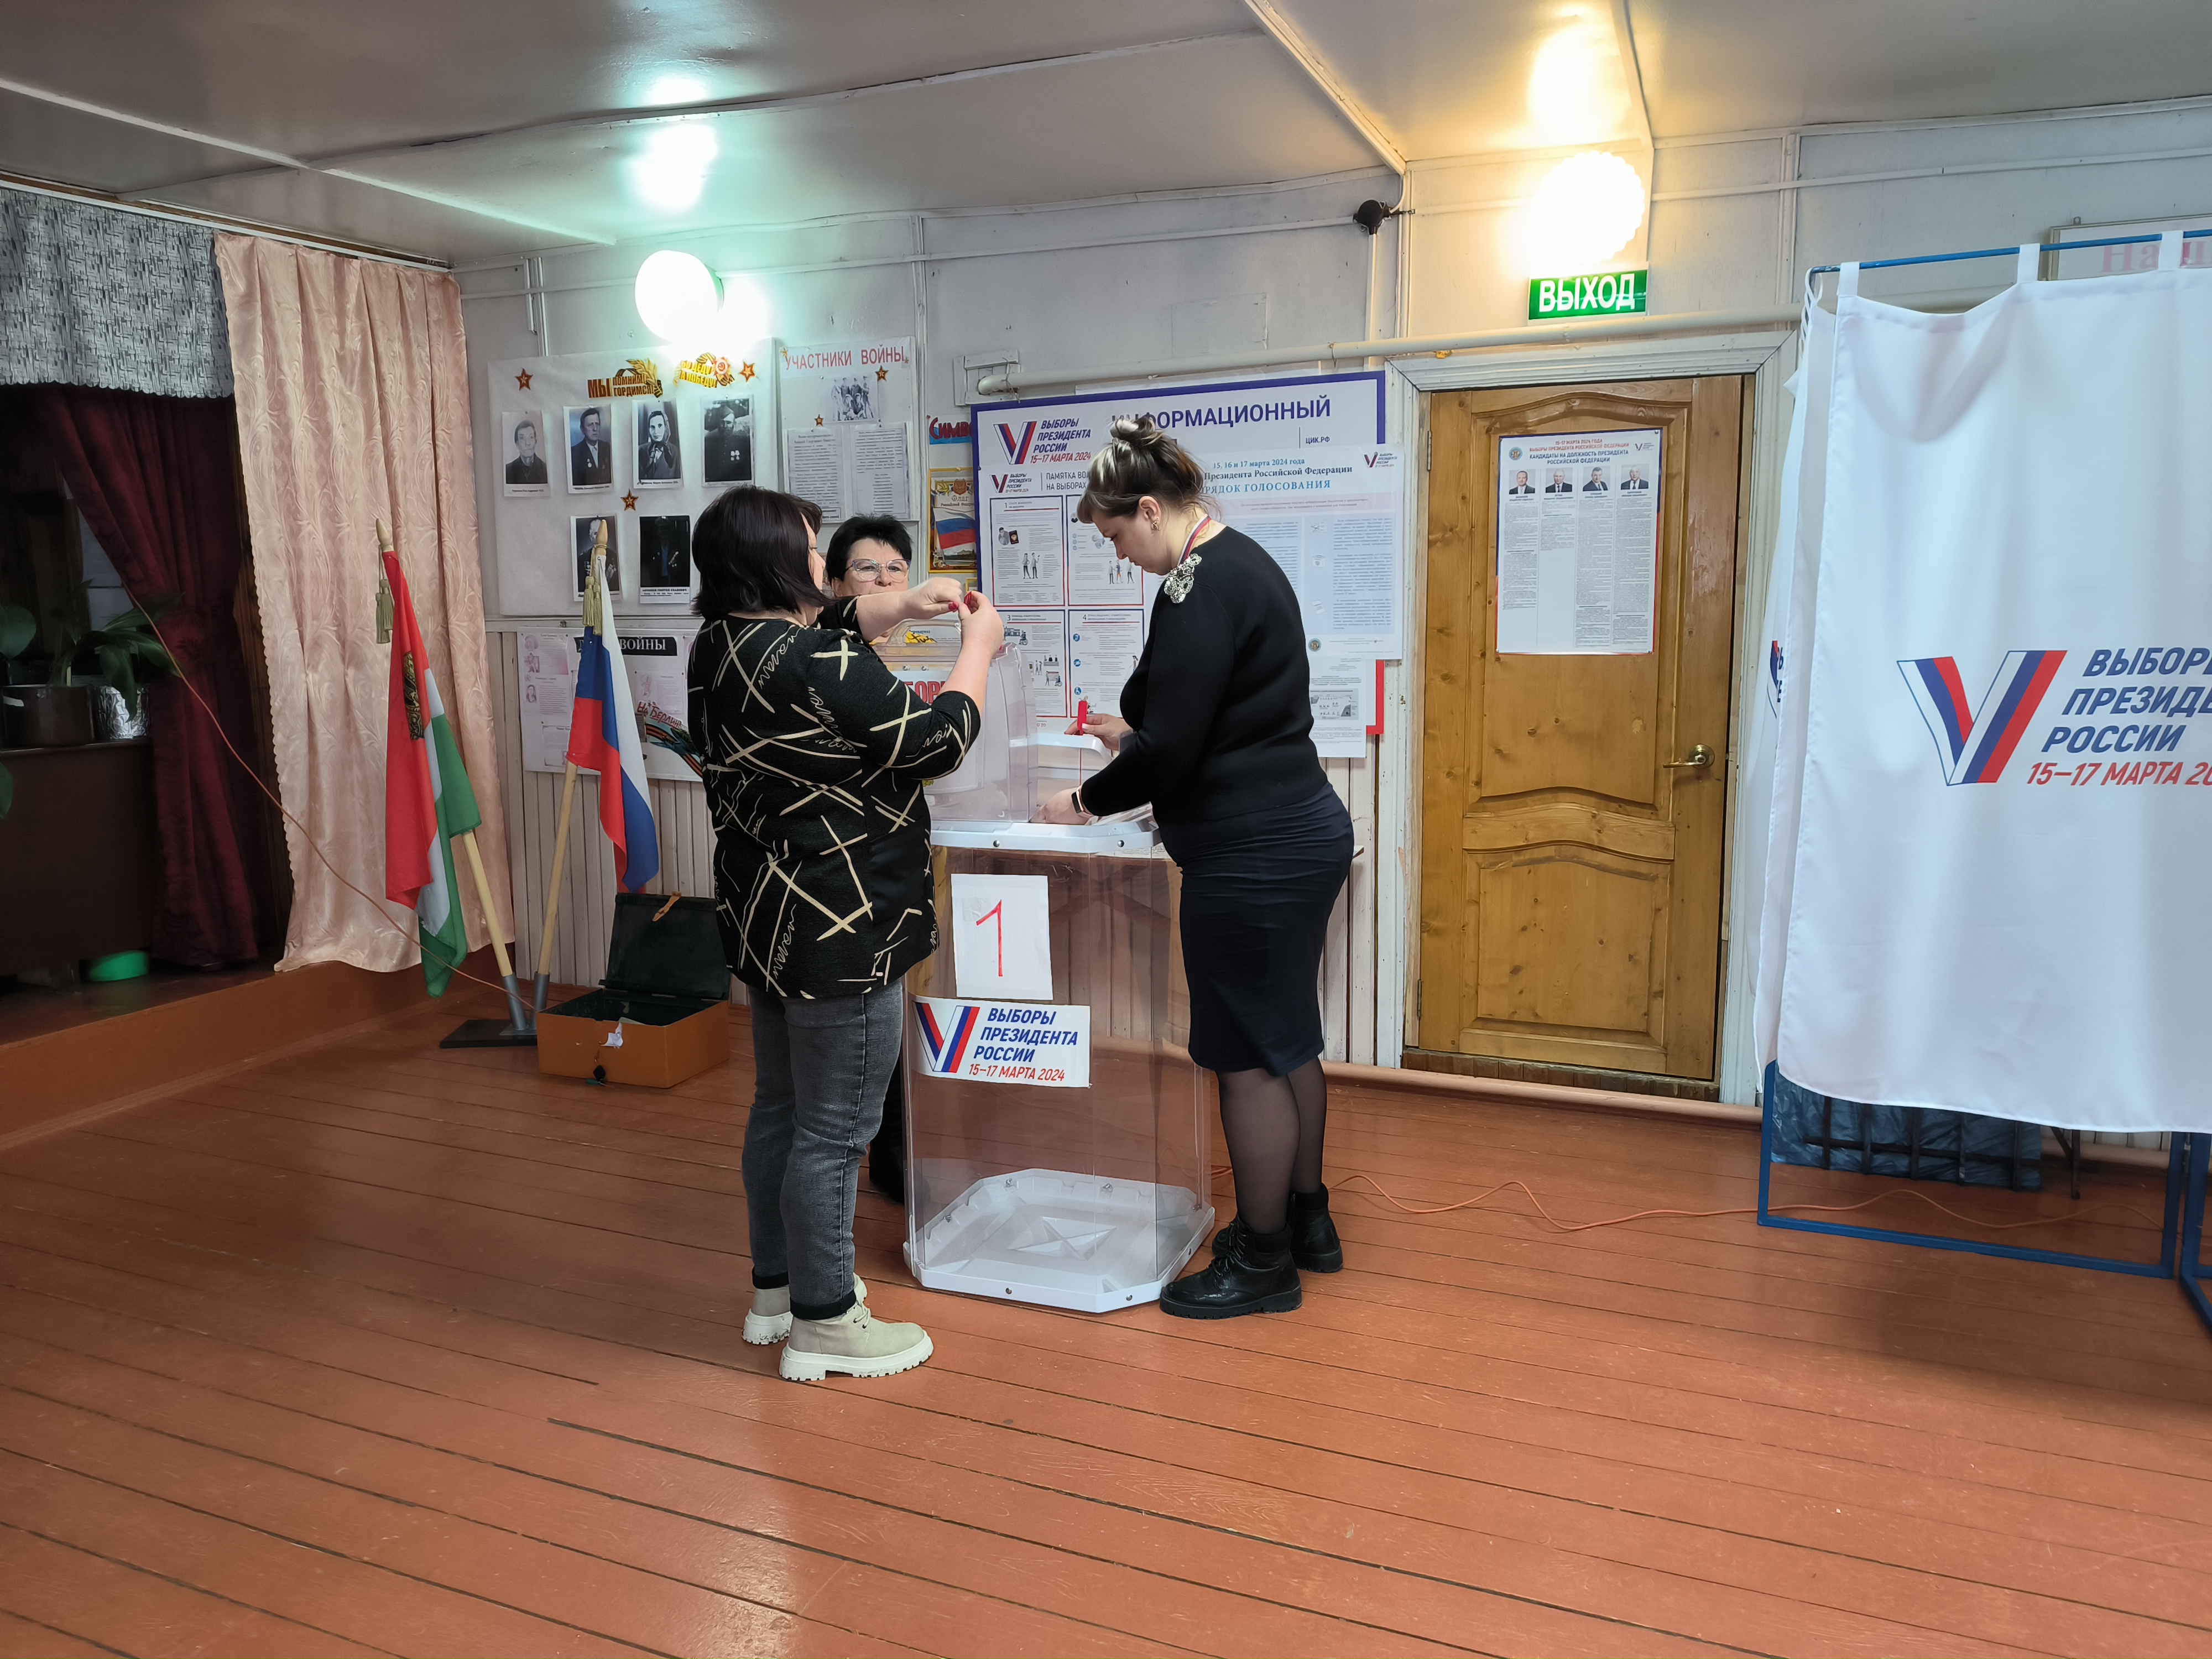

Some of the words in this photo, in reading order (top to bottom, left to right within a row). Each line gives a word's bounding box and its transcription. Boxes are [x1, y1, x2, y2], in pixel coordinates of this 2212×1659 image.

[1539, 273, 1635, 312] ВЫХОД
[785, 351, 852, 370] УЧАСТНИКИ
[861, 344, 904, 364] ВОЙНЫ
[588, 378, 612, 398] МЫ
[1112, 394, 1331, 429] ОРМАЦИОННЫЙ
[1041, 418, 1079, 429] ВЫБОРЫ
[1037, 429, 1091, 441] ПРЕЗИДЕНТА
[1306, 436, 1330, 445] ЦИК.РФ
[1033, 442, 1068, 453] РОССИИ
[1050, 453, 1073, 462] МАРТА
[1074, 451, 1091, 461] 2024
[1204, 472, 1252, 482] Президента
[1255, 467, 1302, 477] Российской
[1305, 467, 1352, 476] Федерации
[1056, 481, 1087, 490] ВЫБОРАХ
[1245, 479, 1331, 492] ГОЛОСОВАНИЯ
[619, 635, 666, 650] ВОЙНЫ
[2041, 724, 2187, 753] РОССИИ
[2100, 761, 2184, 786] МАРТА
[976, 899, 1003, 977] 1
[987, 1008, 1057, 1025] ВЫБОРЫ
[980, 1026, 1078, 1046] ПРЕЗИДЕНТА
[973, 1046, 1035, 1062] РОССИИ
[999, 1066, 1035, 1080] МАРТА
[1037, 1068, 1065, 1082] 2024
